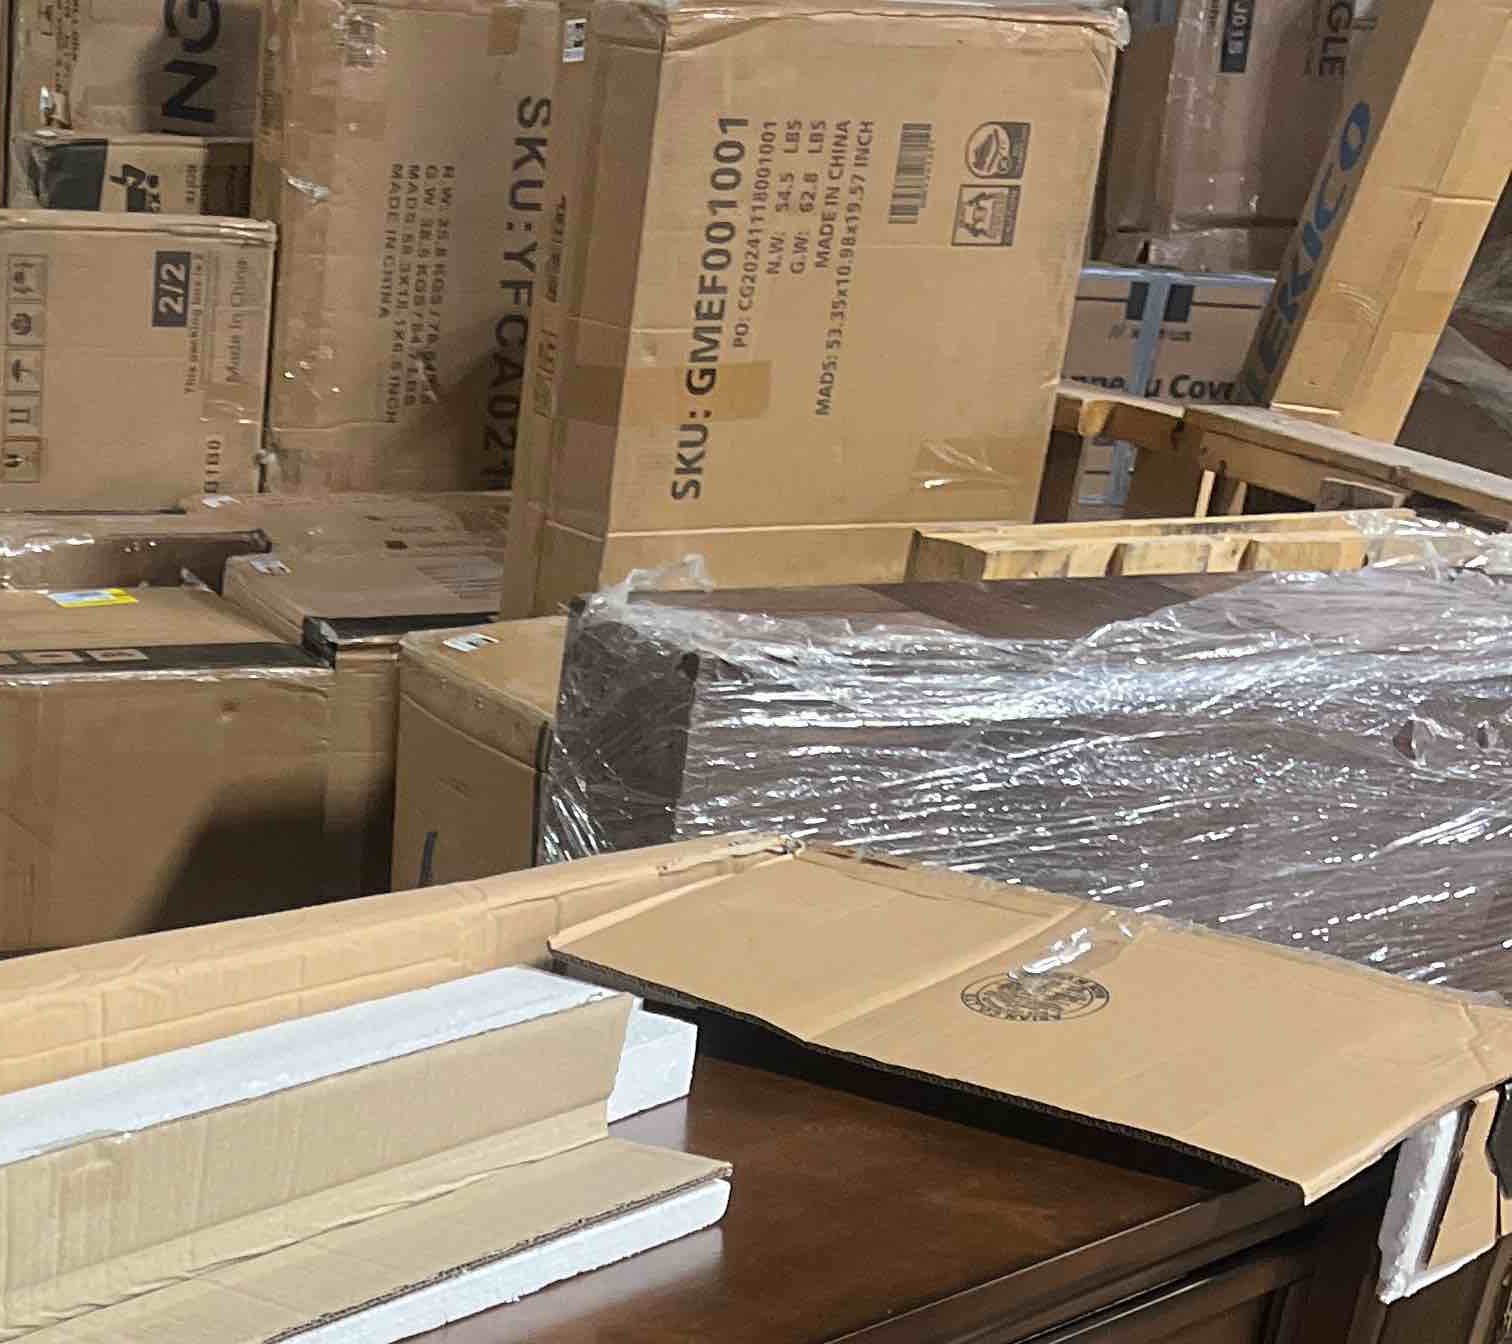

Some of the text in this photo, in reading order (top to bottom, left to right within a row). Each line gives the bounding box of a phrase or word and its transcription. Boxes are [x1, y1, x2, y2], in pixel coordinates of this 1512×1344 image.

[784, 120, 803, 154] LBS
[808, 120, 827, 154] LBS
[854, 120, 874, 168] INCH
[814, 119, 851, 268] MADE IN CHINA
[157, 262, 186, 315] 2/2
[671, 117, 749, 501] SKU: GMEF001001
